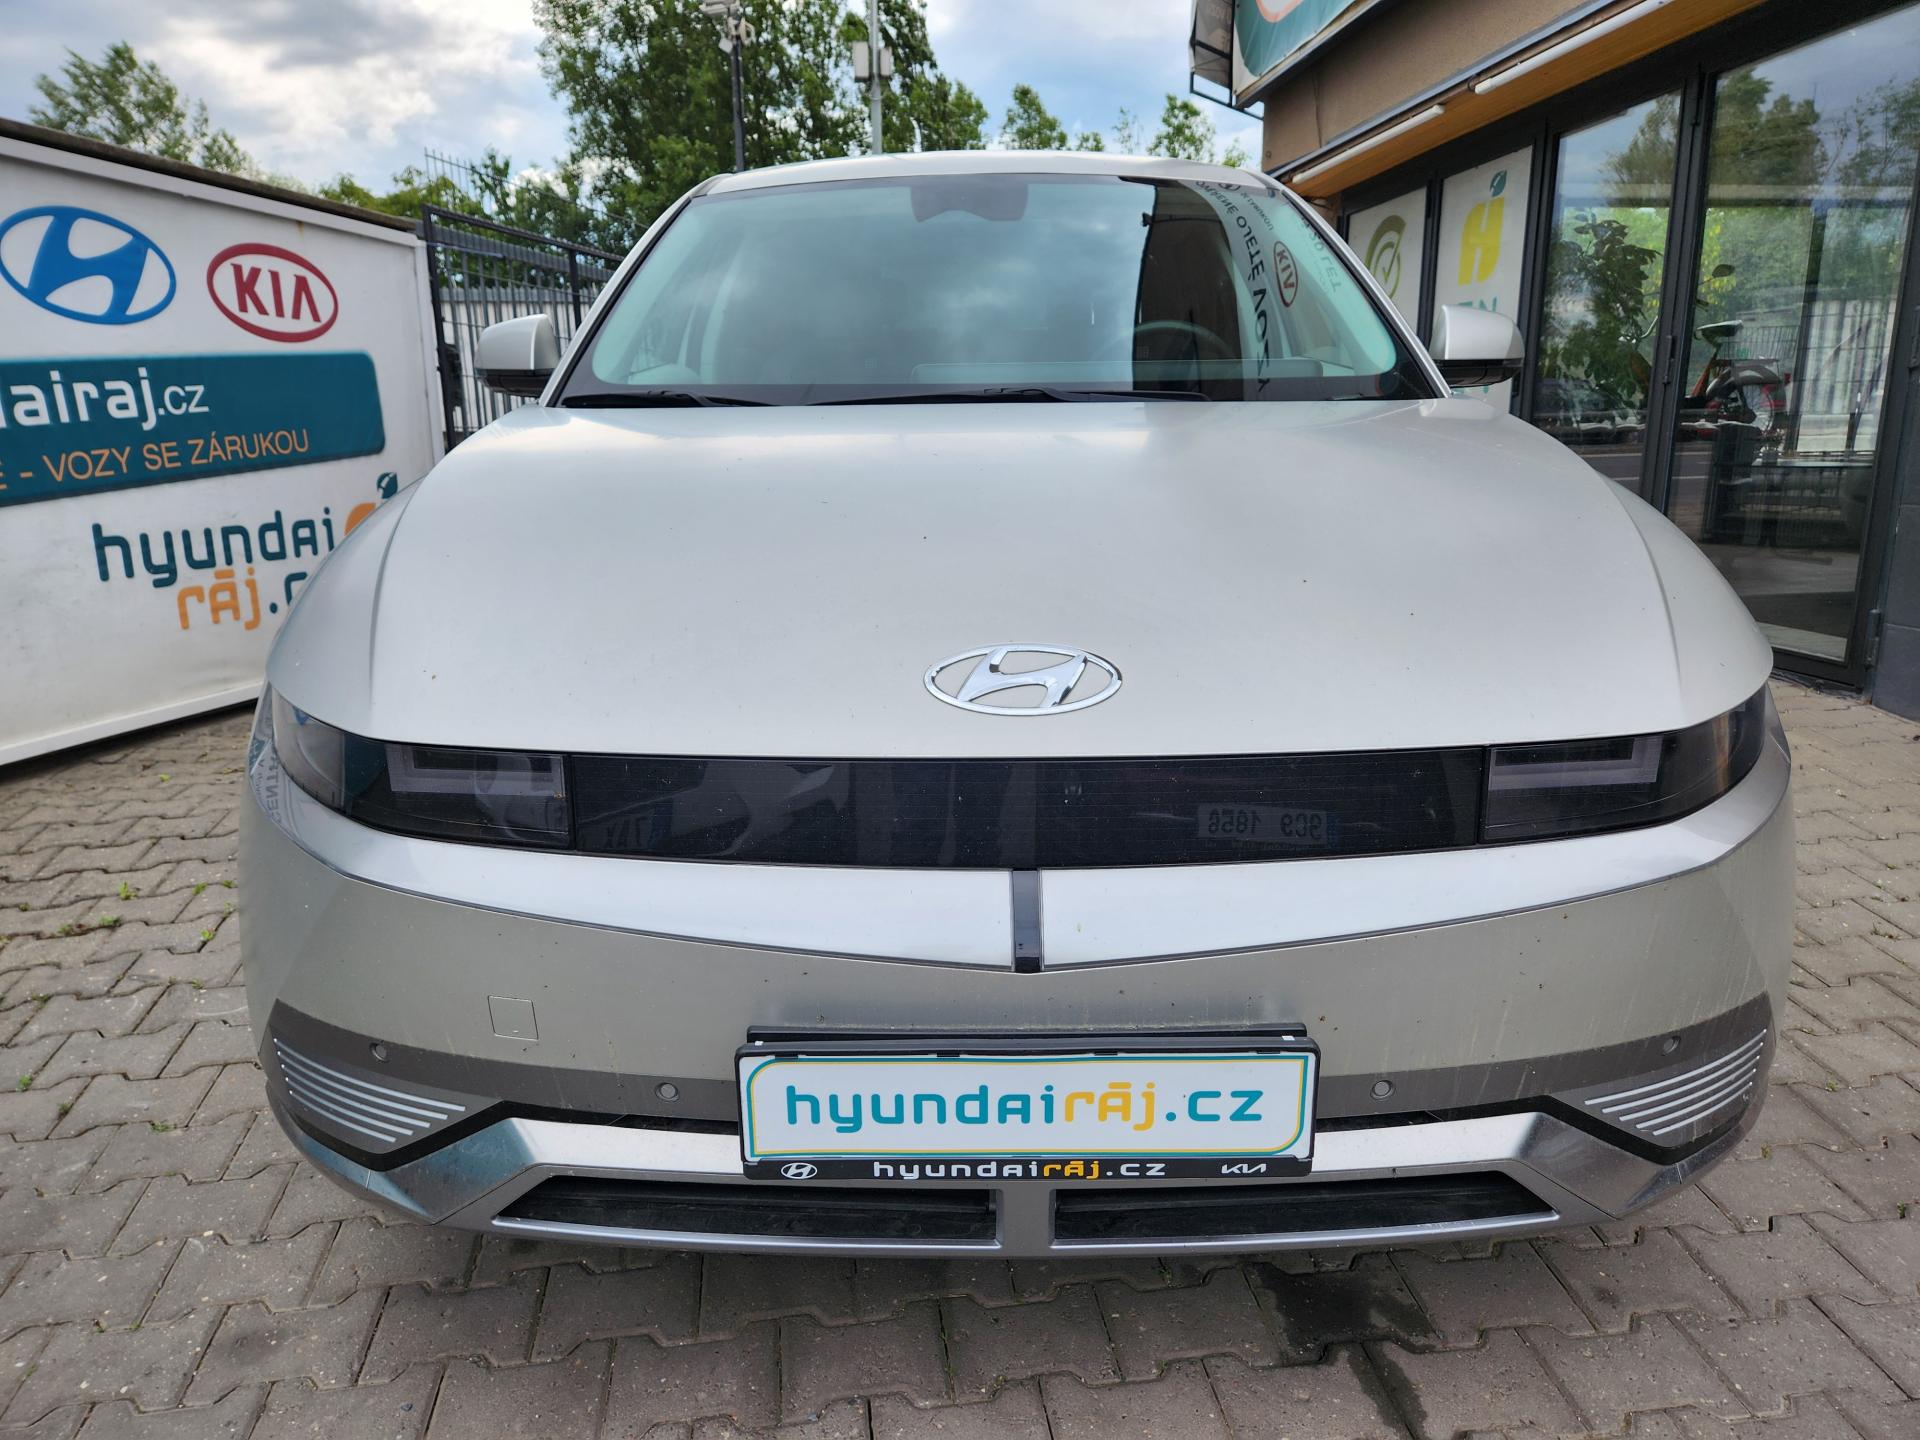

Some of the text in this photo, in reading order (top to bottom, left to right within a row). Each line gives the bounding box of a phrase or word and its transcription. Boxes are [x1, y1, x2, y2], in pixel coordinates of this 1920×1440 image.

[230, 262, 321, 323] KIA
[42, 446, 131, 483] VOZY
[143, 441, 182, 471] SE
[188, 428, 309, 465] ZÁRUKOU
[92, 506, 335, 588] hyundai
